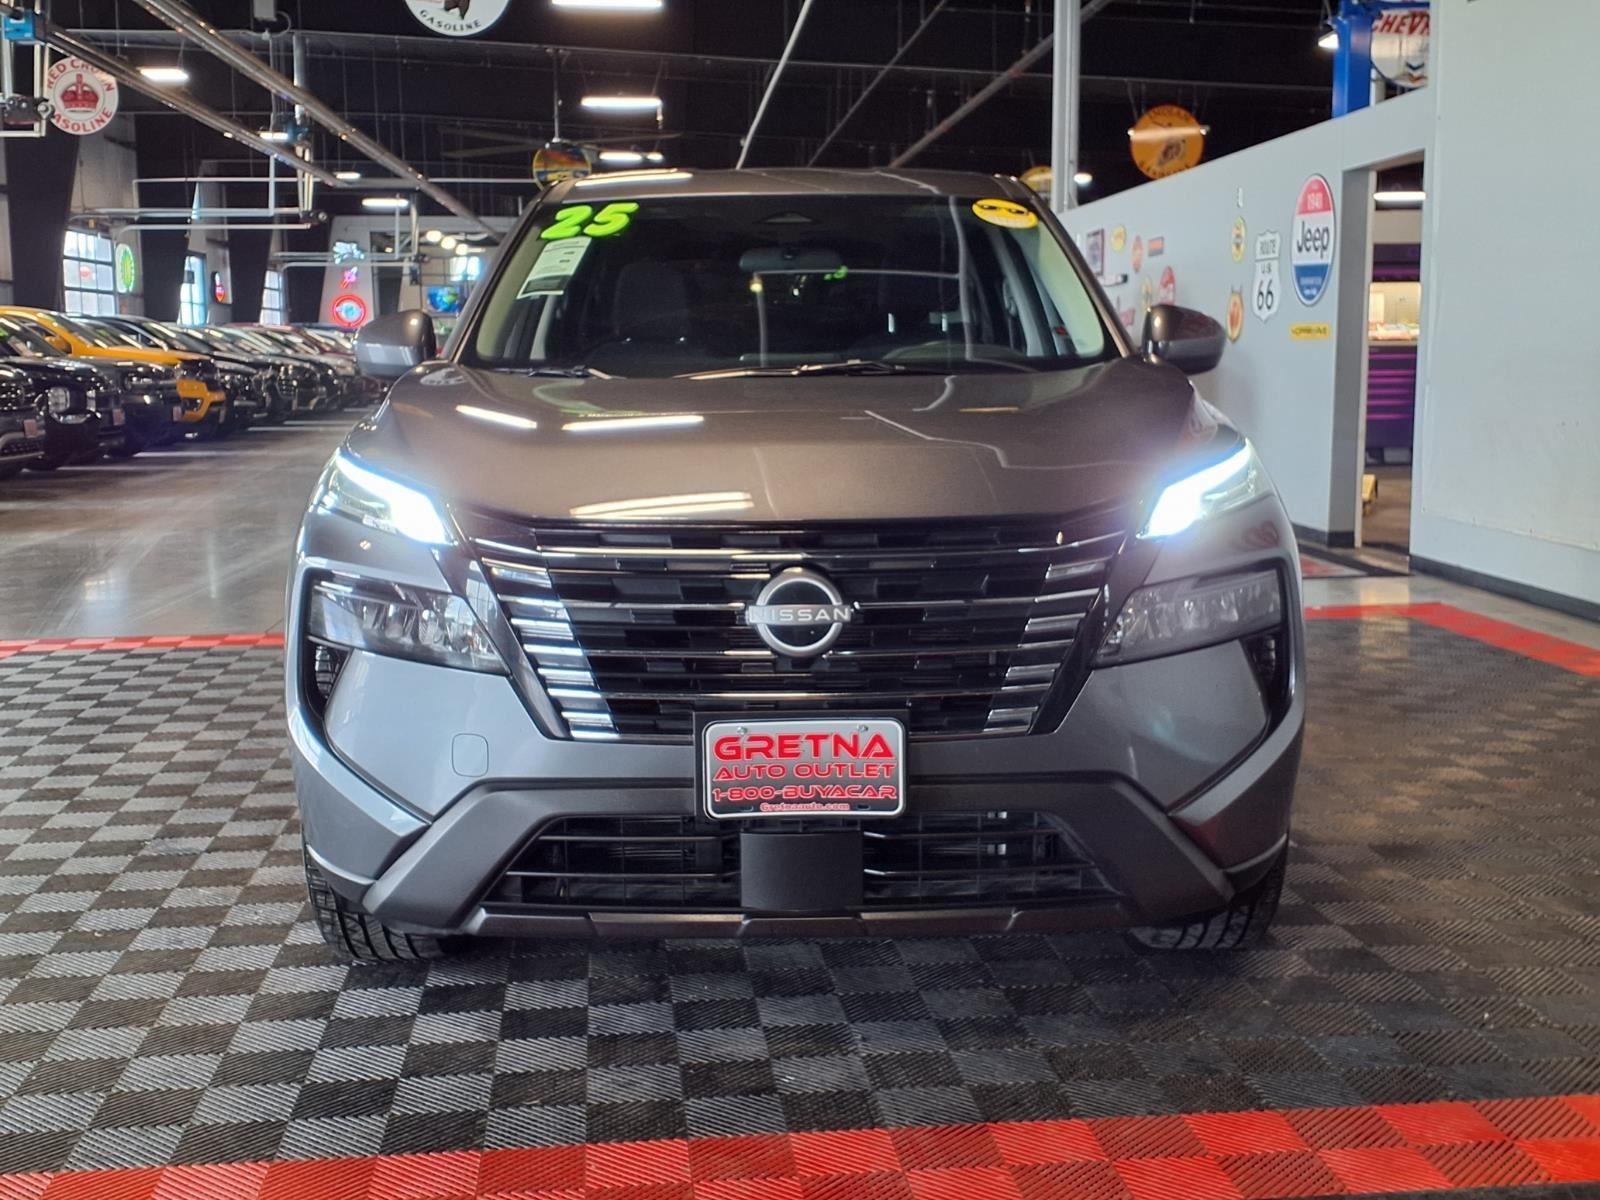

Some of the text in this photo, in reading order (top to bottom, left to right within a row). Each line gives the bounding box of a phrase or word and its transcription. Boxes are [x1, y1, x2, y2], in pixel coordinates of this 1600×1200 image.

[420, 9, 481, 31] GASOLINE
[53, 107, 112, 132] ASOLINE
[540, 202, 639, 240] 25
[1259, 239, 1276, 256] ROUTE
[1297, 221, 1330, 259] Jeep
[1256, 279, 1274, 310] 66
[751, 606, 849, 622] NISSAN
[713, 732, 895, 761] GRETNA
[714, 763, 897, 781] AUTO OUTLET
[712, 785, 897, 802] 1-800-BUYACAR
